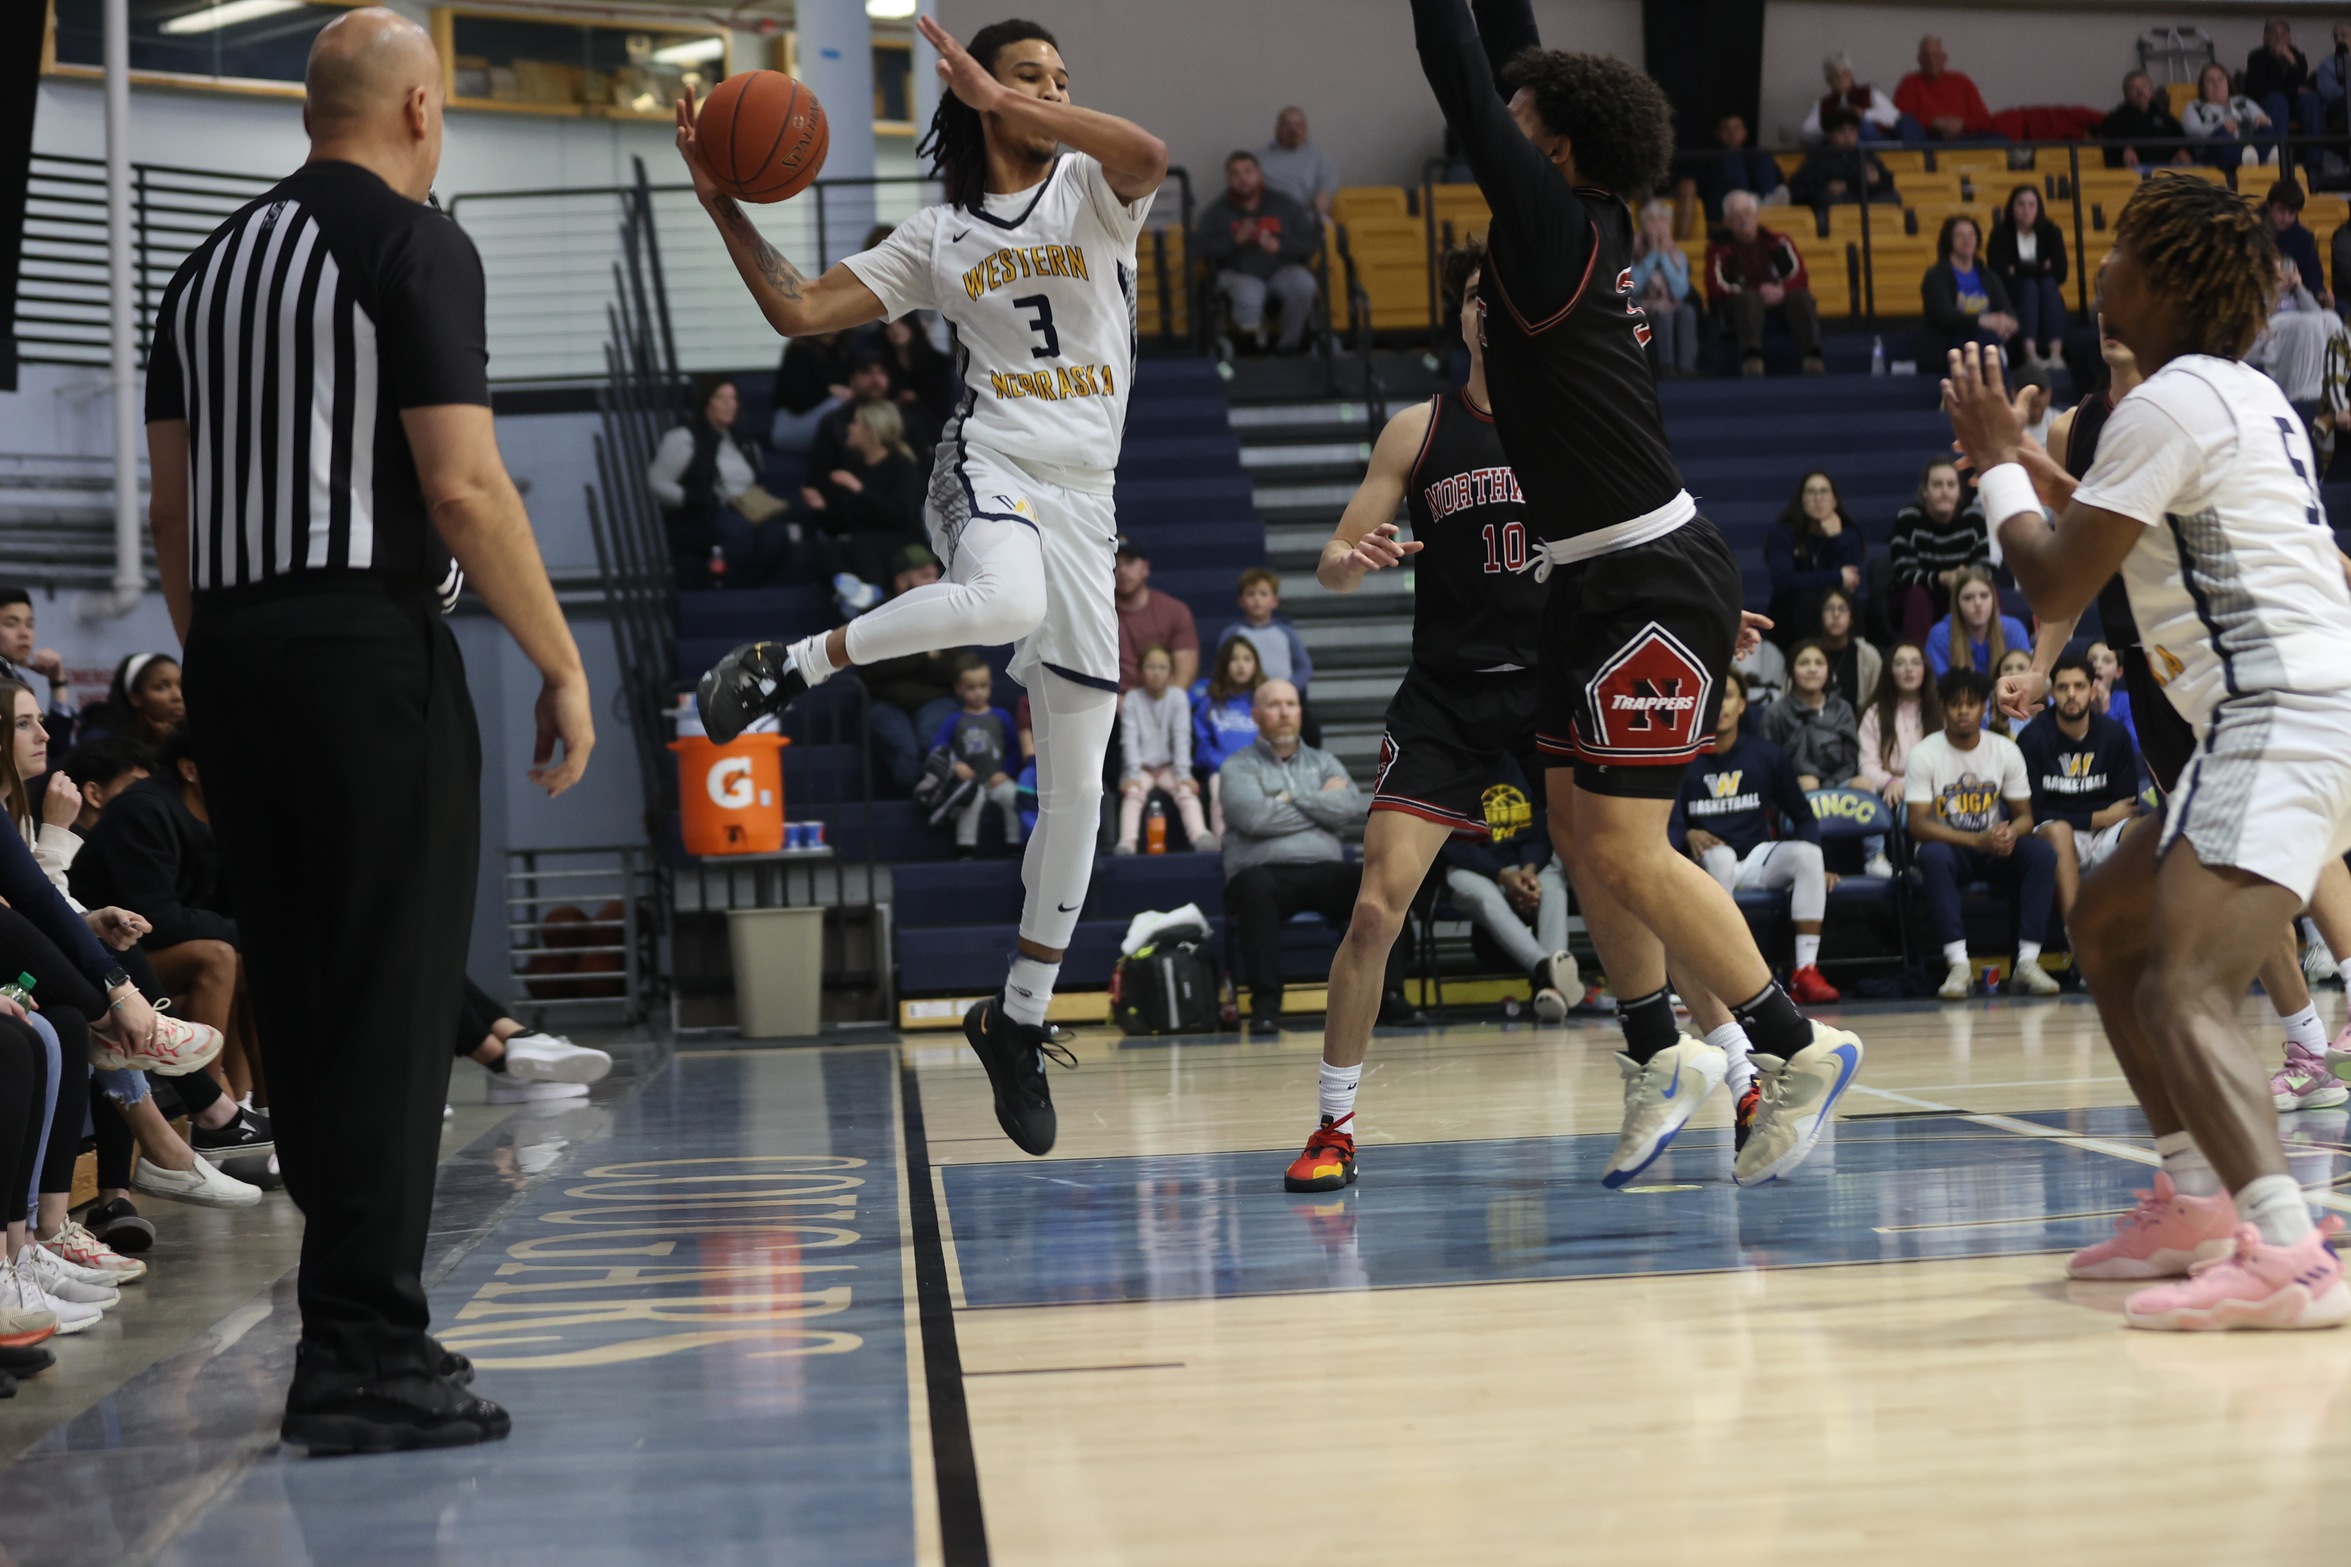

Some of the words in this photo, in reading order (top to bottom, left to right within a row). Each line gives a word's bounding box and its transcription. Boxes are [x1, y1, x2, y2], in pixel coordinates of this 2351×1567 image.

[962, 244, 1090, 302] WESTERN
[1012, 293, 1061, 359] 3
[989, 363, 1114, 401] NEBRASKA
[1482, 521, 1526, 573] 10
[1610, 694, 1696, 711] TRAPPERS
[706, 756, 755, 810] G
[1688, 791, 1761, 816] BASKETBALL
[432, 1155, 868, 1370] COUGARS
